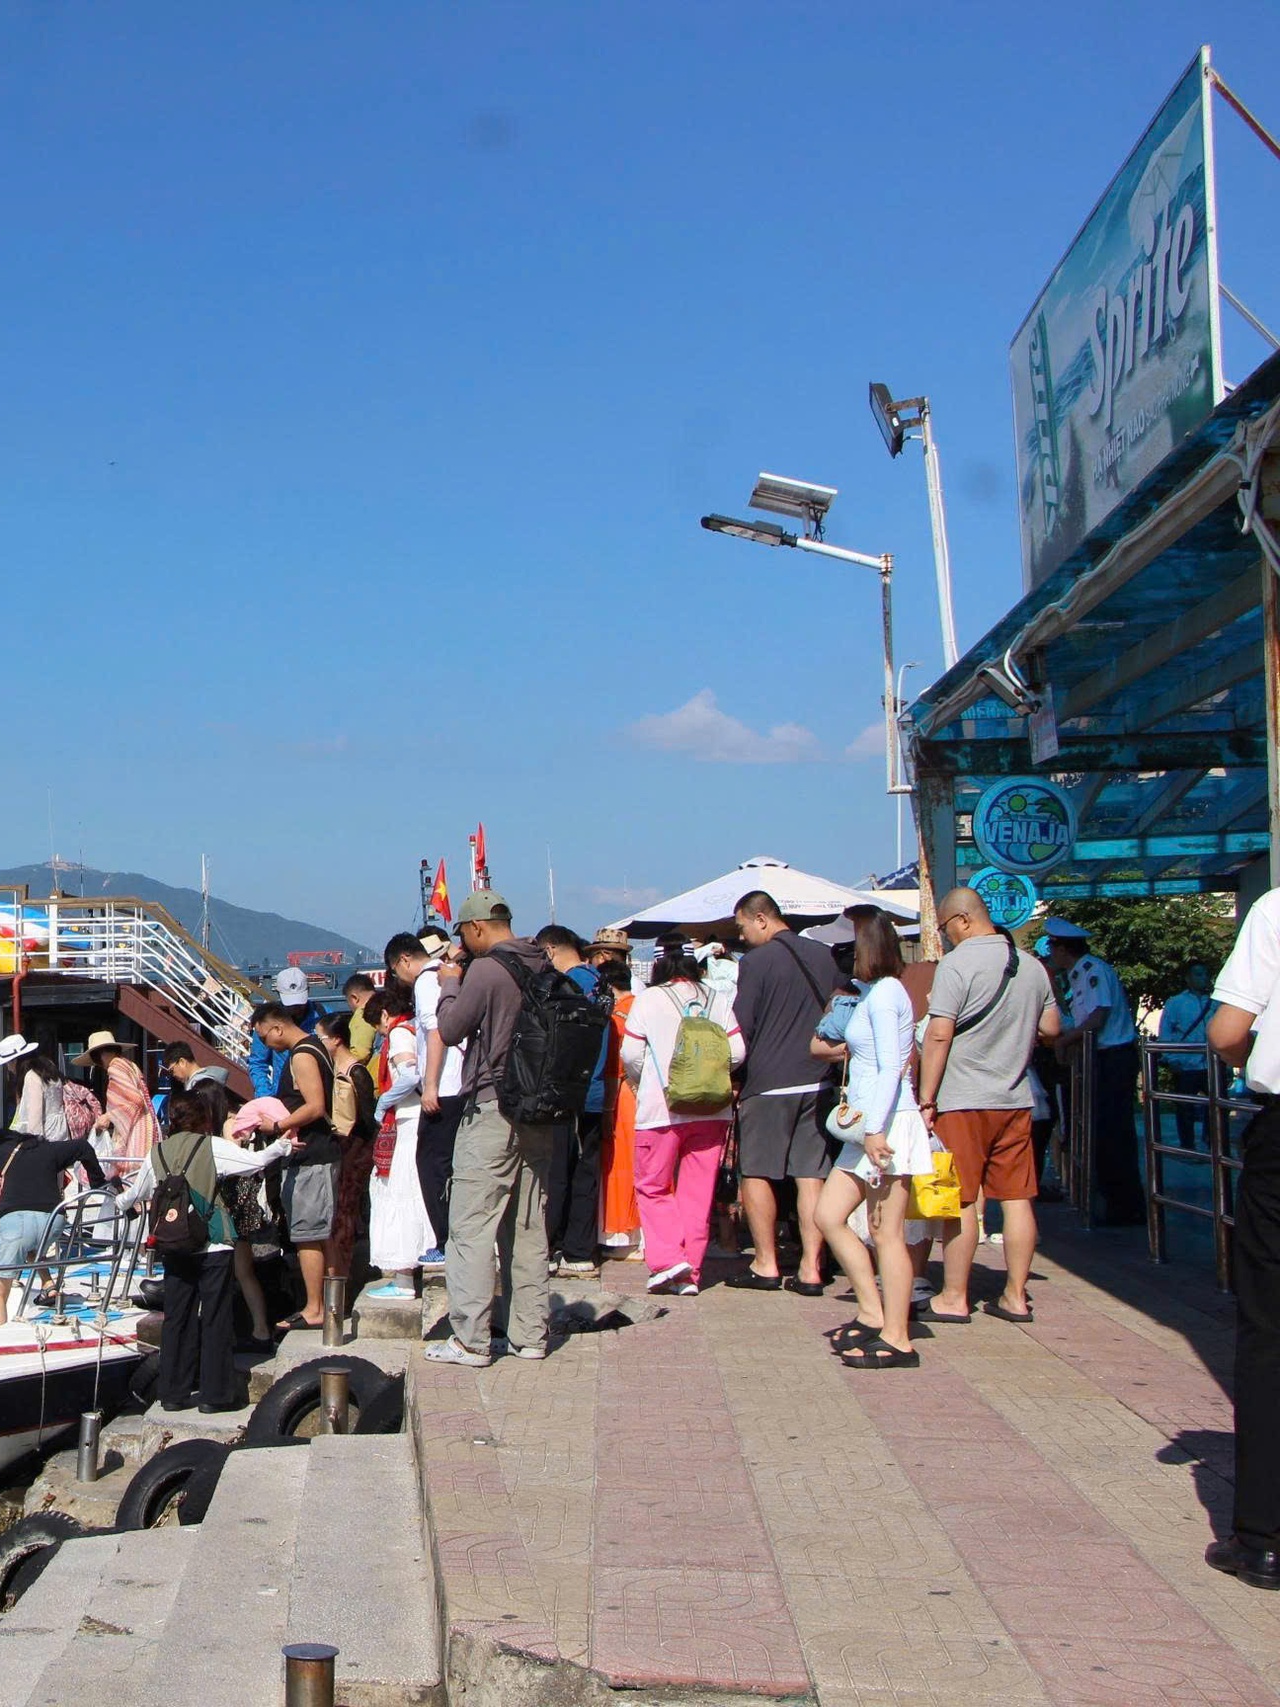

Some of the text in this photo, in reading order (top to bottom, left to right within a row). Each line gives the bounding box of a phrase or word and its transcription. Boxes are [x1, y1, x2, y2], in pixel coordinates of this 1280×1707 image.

[1089, 203, 1195, 429] Sprite
[984, 820, 1070, 846] VENAJA
[984, 896, 1030, 912] ENAJA
